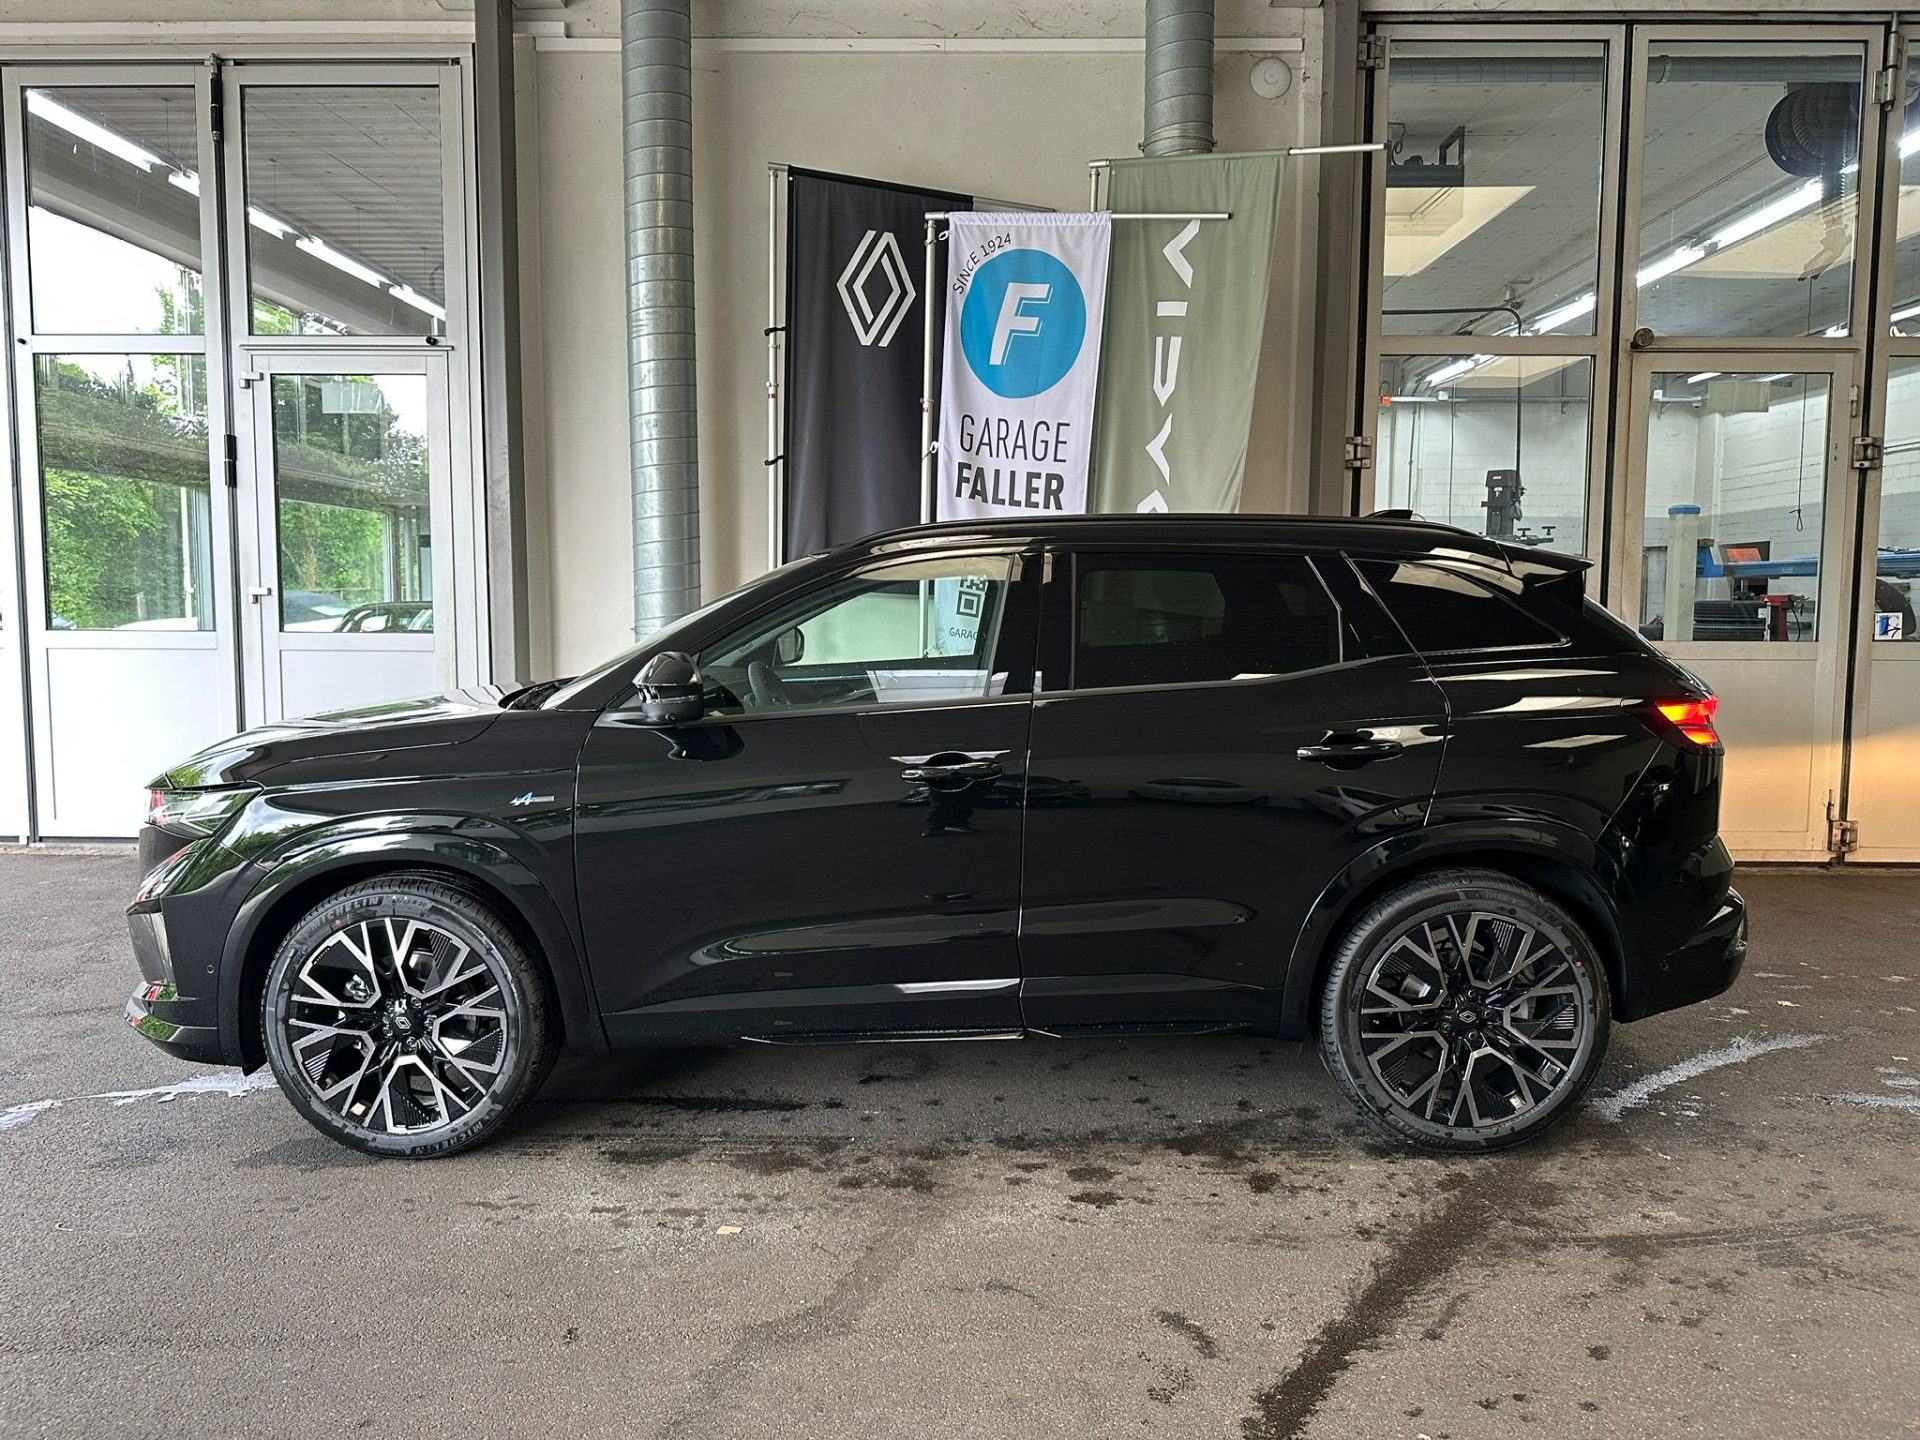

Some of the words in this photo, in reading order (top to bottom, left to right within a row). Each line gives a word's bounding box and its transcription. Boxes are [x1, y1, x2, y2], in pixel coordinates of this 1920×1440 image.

[952, 251, 980, 294] SINCE
[980, 232, 1012, 257] 1924
[989, 282, 1054, 366] F
[959, 414, 1071, 463] GARAGE
[955, 461, 1065, 511] FALLER
[312, 896, 380, 930] MICHELIN
